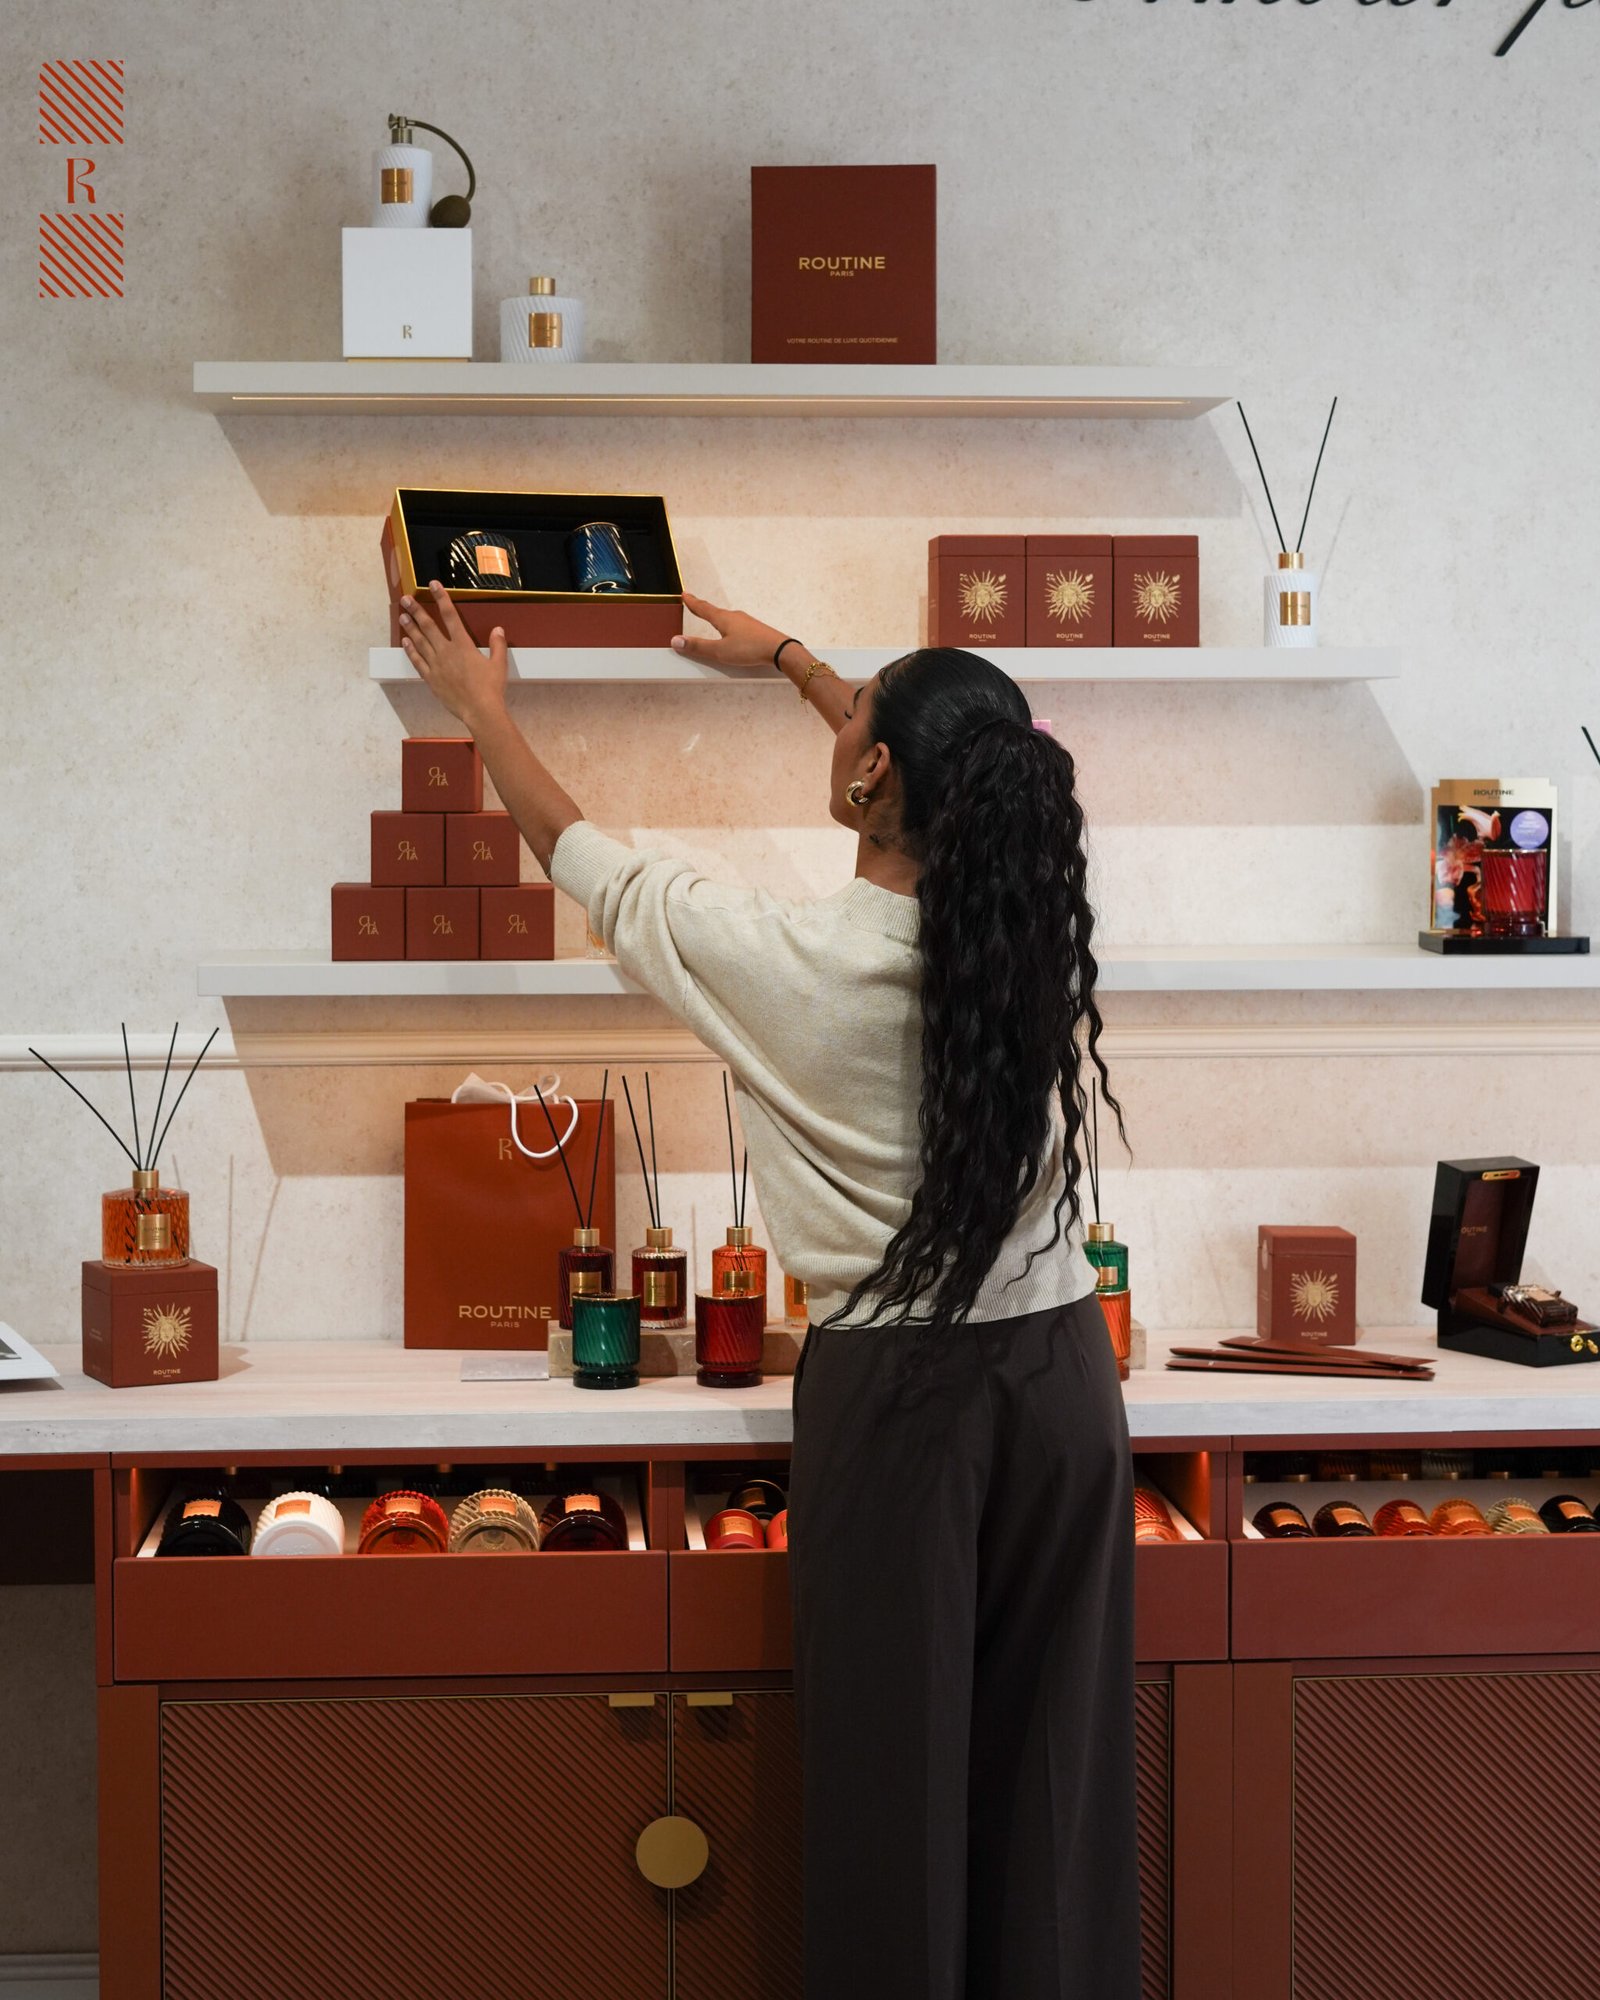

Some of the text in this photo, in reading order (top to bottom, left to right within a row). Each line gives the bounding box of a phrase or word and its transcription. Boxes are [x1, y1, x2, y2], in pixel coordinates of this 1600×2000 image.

[799, 256, 886, 269] ROUTINE
[402, 324, 413, 340] R
[498, 1138, 513, 1160] R
[459, 1305, 552, 1319] ROUTINE
[490, 1321, 520, 1329] PARIS
